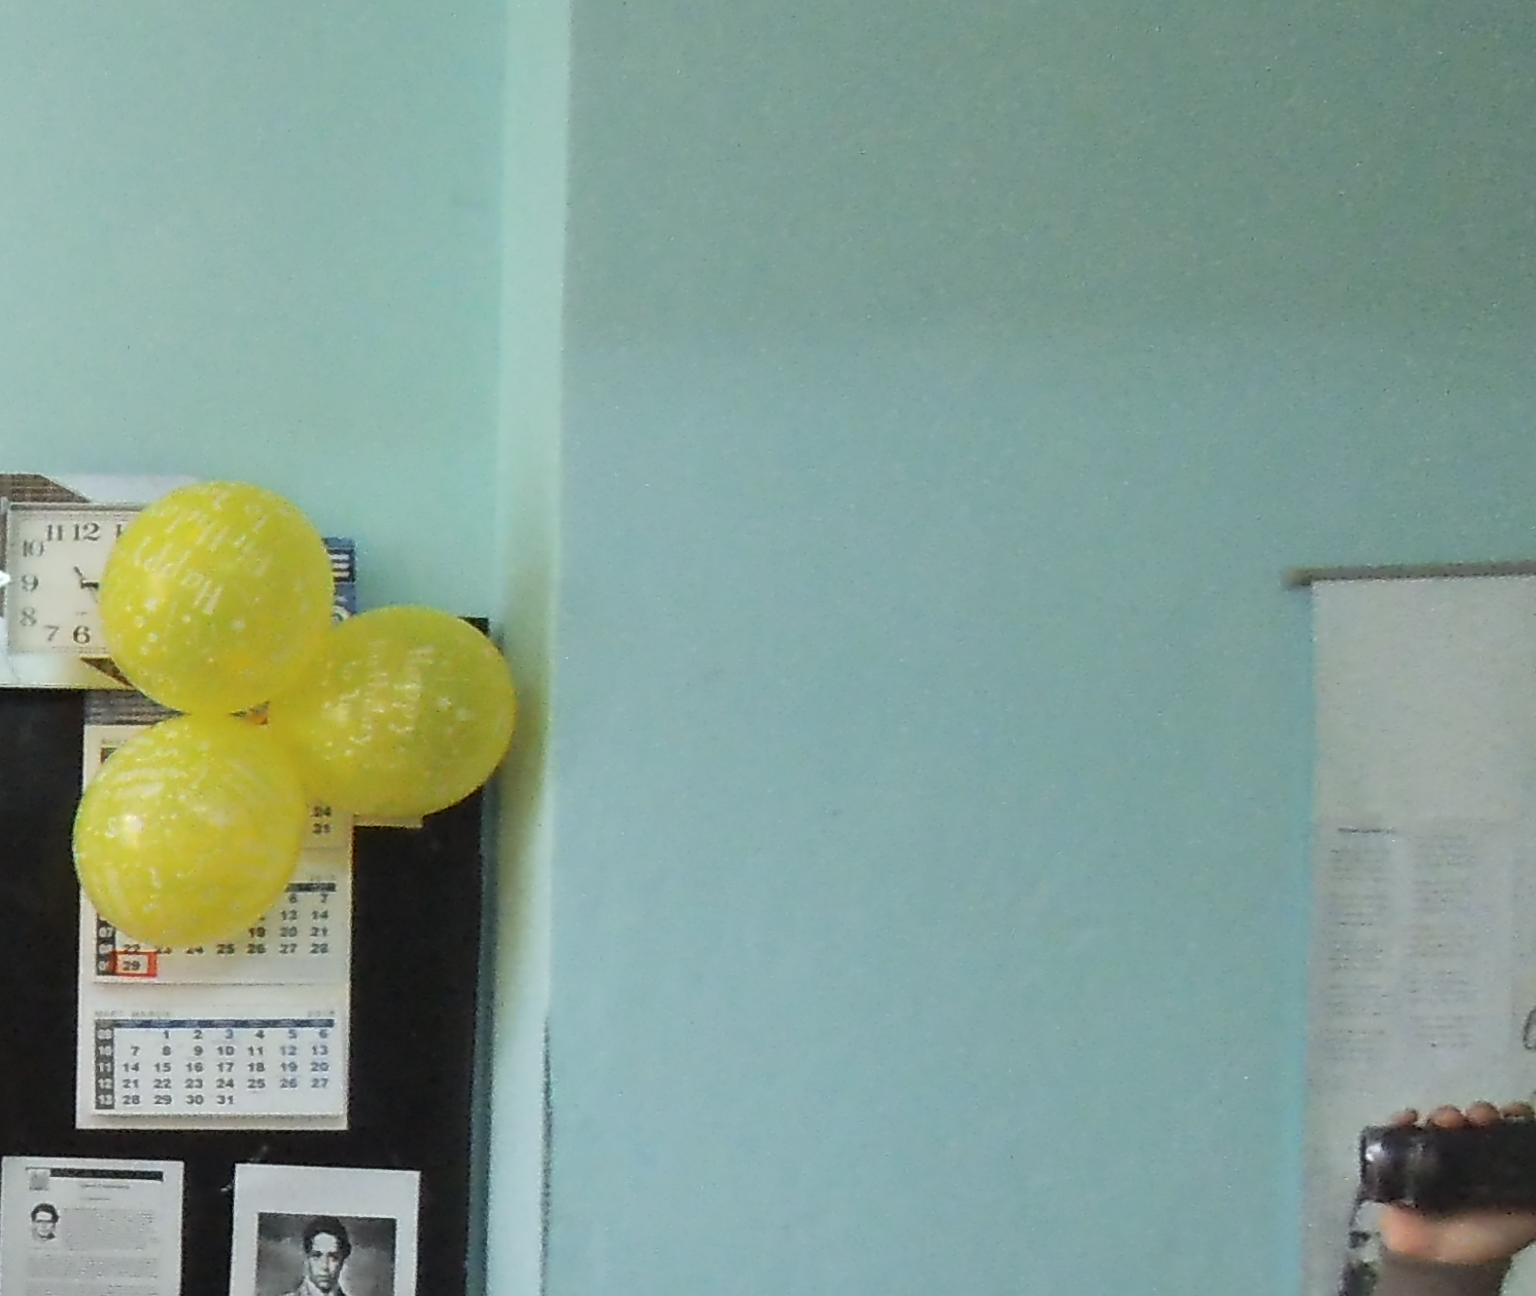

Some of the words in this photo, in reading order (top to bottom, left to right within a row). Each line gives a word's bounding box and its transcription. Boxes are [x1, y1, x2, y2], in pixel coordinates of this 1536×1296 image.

[47, 524, 64, 542] 11
[73, 522, 100, 541] 12
[21, 539, 45, 557] 10
[21, 574, 40, 592] 9
[19, 609, 37, 627] 8
[44, 626, 59, 642] 7
[72, 626, 92, 645] 6
[194, 1030, 203, 1040] 2
[255, 1030, 266, 1040] 4
[288, 1030, 298, 1040] 5
[318, 1030, 328, 1040] 6
[131, 1046, 140, 1056] 7
[194, 1046, 203, 1056] 9
[217, 1046, 235, 1056] 10
[247, 1046, 265, 1056] 11
[280, 1046, 297, 1056] 12
[312, 1046, 329, 1056] 13
[123, 1063, 140, 1073] 14
[154, 1063, 172, 1073] 15
[185, 1063, 204, 1073] 16
[217, 1063, 235, 1073] 17
[248, 1063, 266, 1073] 18
[280, 1063, 298, 1073] 19
[311, 1063, 329, 1073] 20
[123, 1079, 140, 1089] 21
[153, 1079, 172, 1089] 22
[185, 1079, 204, 1089] 23
[216, 1079, 235, 1089] 24
[247, 1079, 266, 1089] 25
[311, 1079, 329, 1089] 27
[123, 1095, 141, 1105] 28
[153, 1095, 172, 1105] 29
[185, 1095, 204, 1105] 30
[217, 1095, 235, 1105] 31
